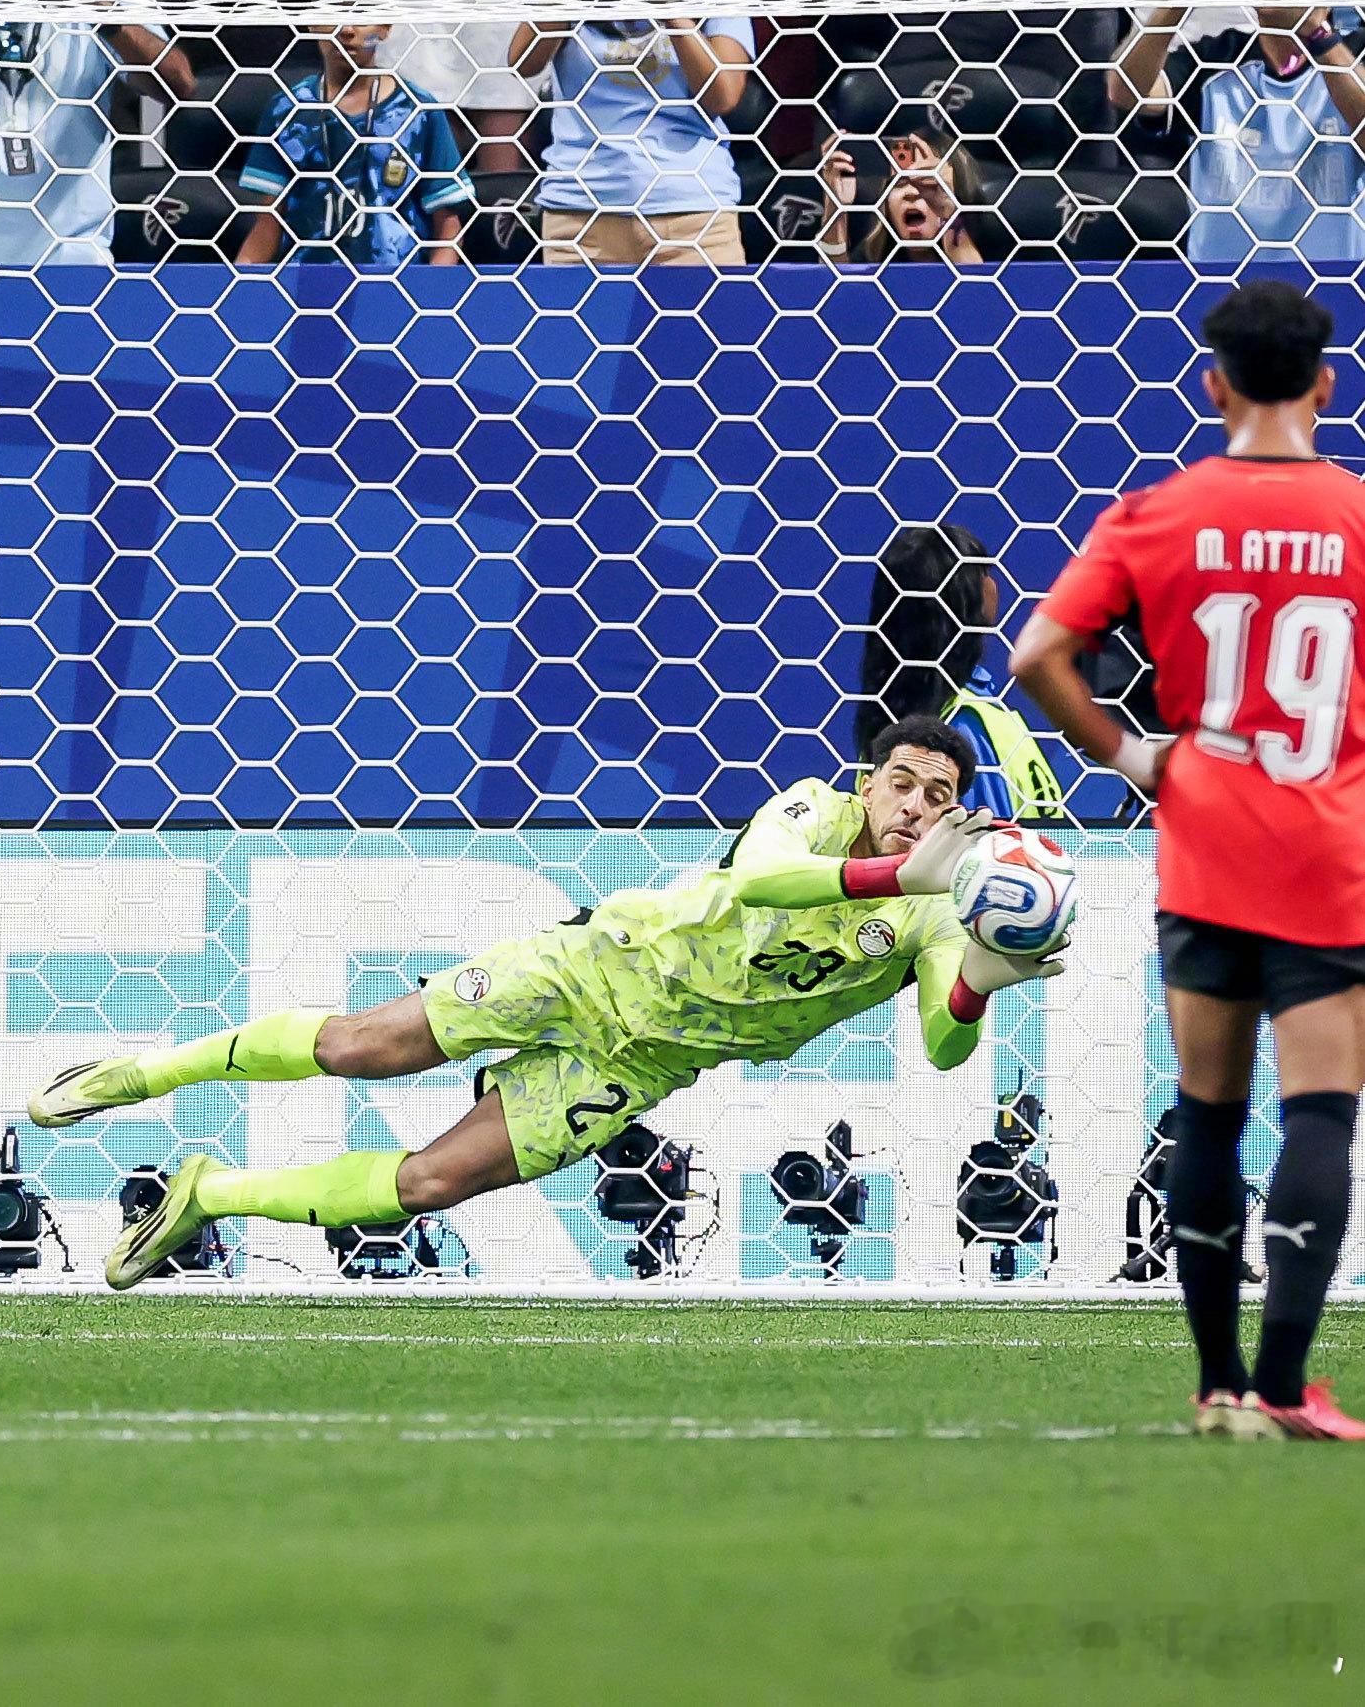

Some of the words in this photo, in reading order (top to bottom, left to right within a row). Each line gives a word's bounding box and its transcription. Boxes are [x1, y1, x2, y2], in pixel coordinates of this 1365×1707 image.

[1194, 527, 1233, 572] M.
[1241, 529, 1346, 577] ATTIA
[1192, 592, 1358, 786] 19
[749, 939, 848, 994] 23
[565, 1082, 635, 1154] 2
